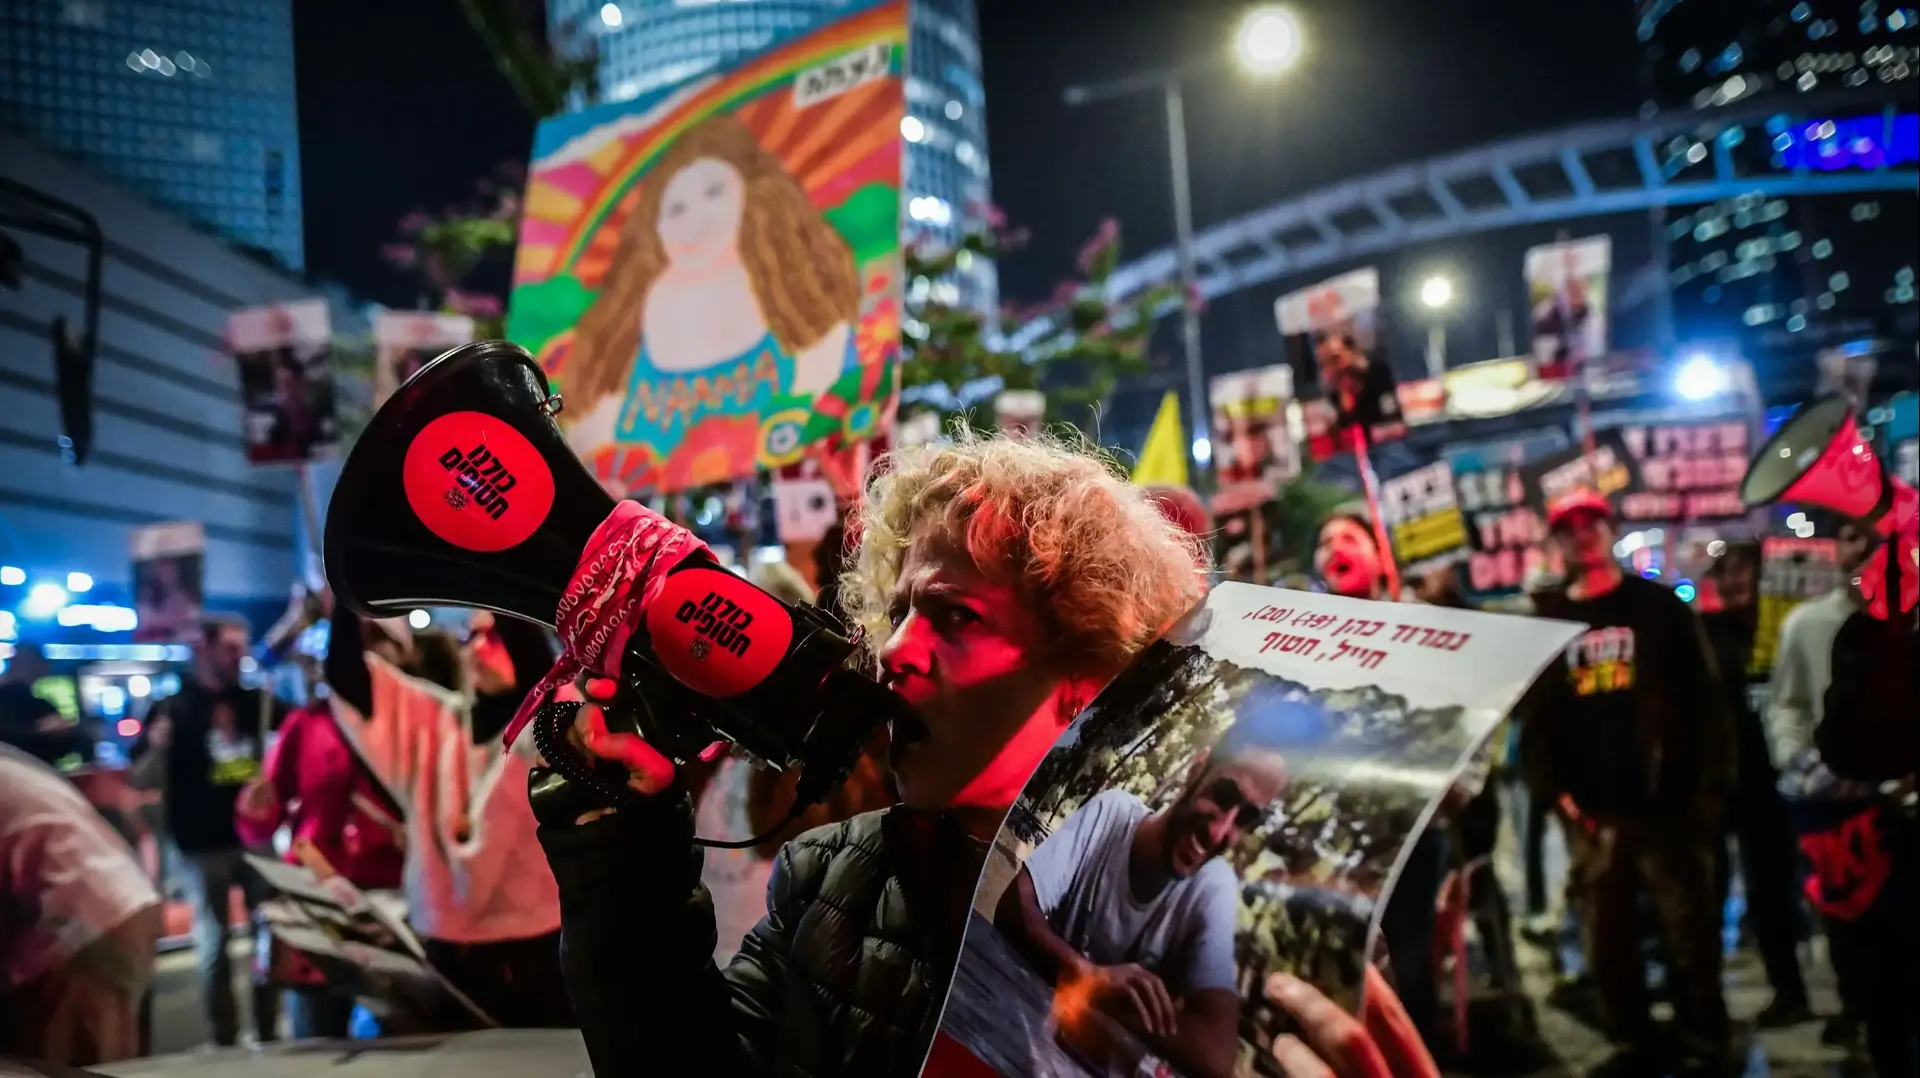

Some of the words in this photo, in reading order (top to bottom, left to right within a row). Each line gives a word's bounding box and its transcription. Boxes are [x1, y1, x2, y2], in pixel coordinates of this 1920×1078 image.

[438, 446, 509, 520] חטופים
[467, 443, 517, 493] כולנו
[700, 591, 754, 630] כולנו
[1329, 617, 1387, 637] כהן
[674, 599, 752, 659] חטופים
[1258, 631, 1322, 655] חטוף
[1389, 624, 1472, 652] נמרוד
[1313, 638, 1388, 669] חייל,
